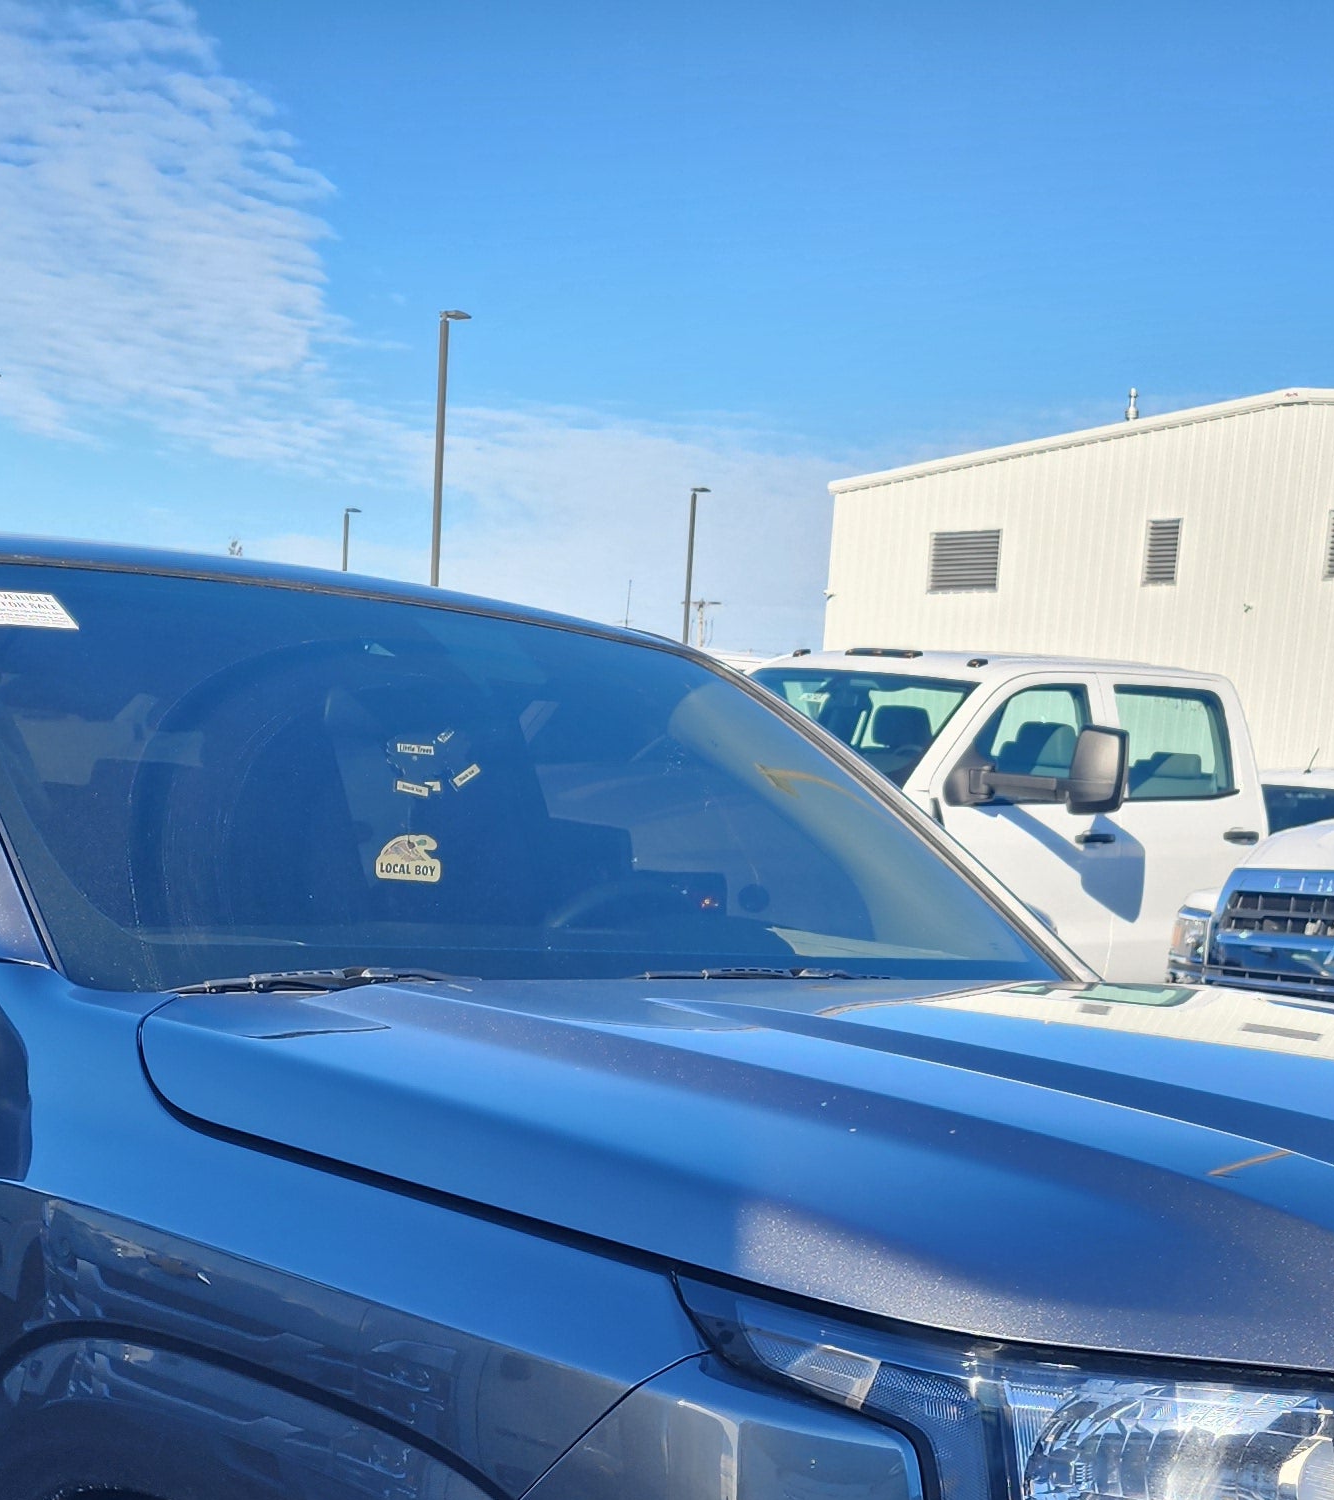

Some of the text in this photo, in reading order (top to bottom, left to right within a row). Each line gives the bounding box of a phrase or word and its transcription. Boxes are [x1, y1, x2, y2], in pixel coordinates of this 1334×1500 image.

[28, 602, 59, 611] SALE
[379, 862, 436, 877] LOCAL BOY
